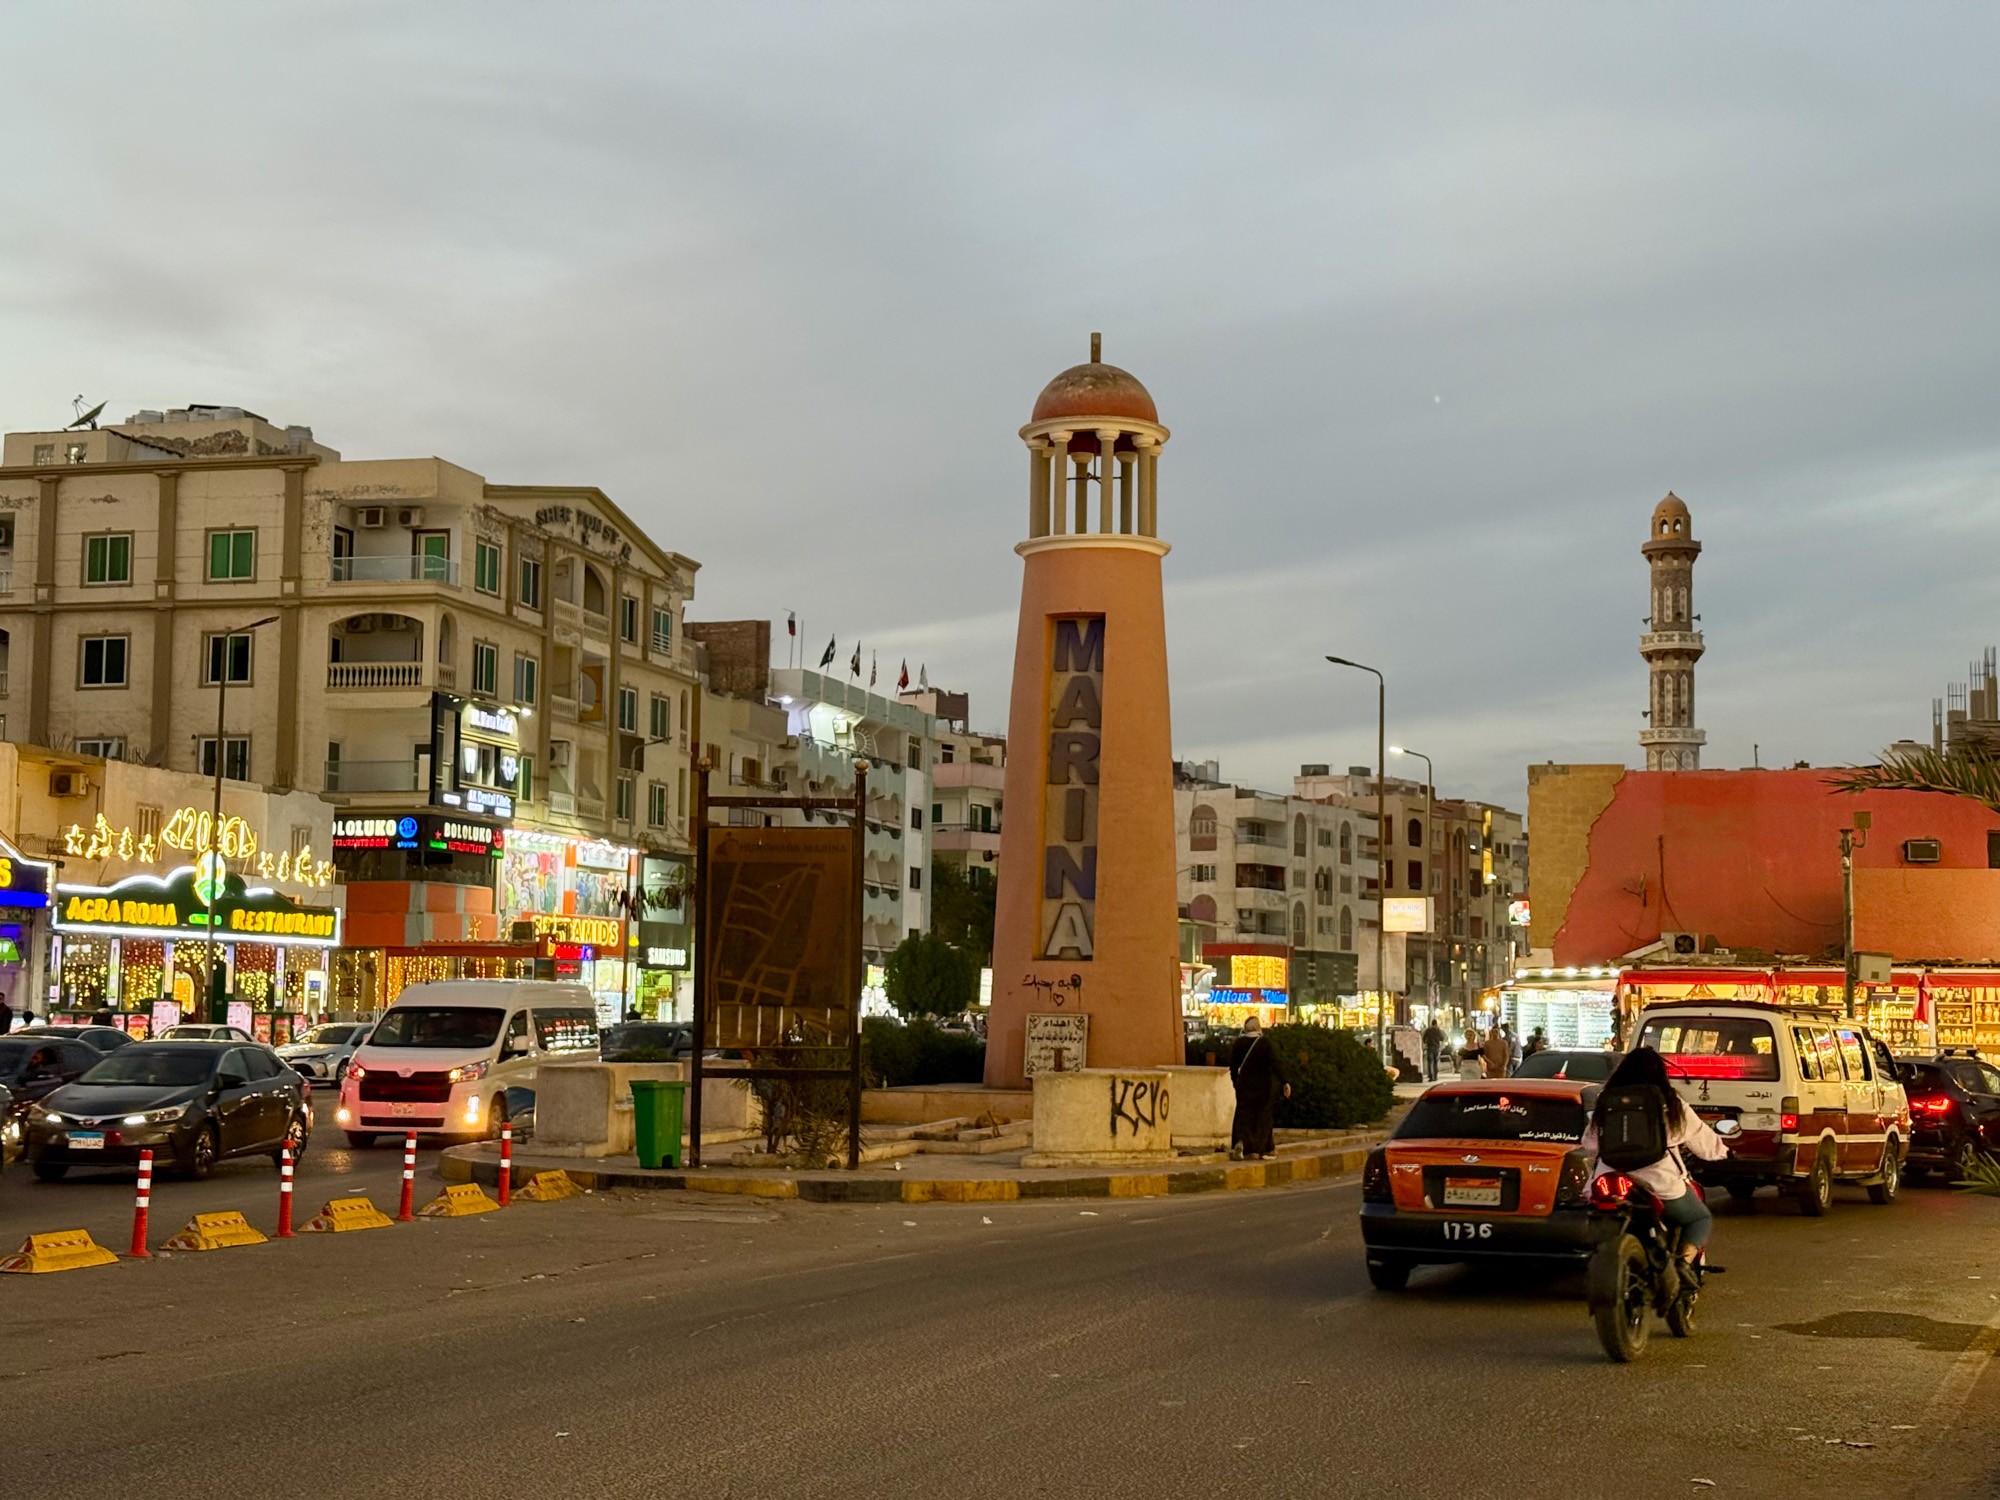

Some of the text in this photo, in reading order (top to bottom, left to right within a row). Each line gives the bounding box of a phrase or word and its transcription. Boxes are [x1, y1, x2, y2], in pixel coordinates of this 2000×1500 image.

[1046, 619, 1105, 956] MARINA
[444, 822, 492, 843] BOLOLUKO
[803, 843, 848, 854] MARINA
[66, 896, 121, 922] AGRA
[122, 900, 178, 926] ROMA
[231, 908, 334, 936] RESTAURANT
[647, 946, 687, 966] SAMSUNG
[1745, 1090, 1772, 1099] الموقف
[1443, 1220, 1494, 1241] 1736
